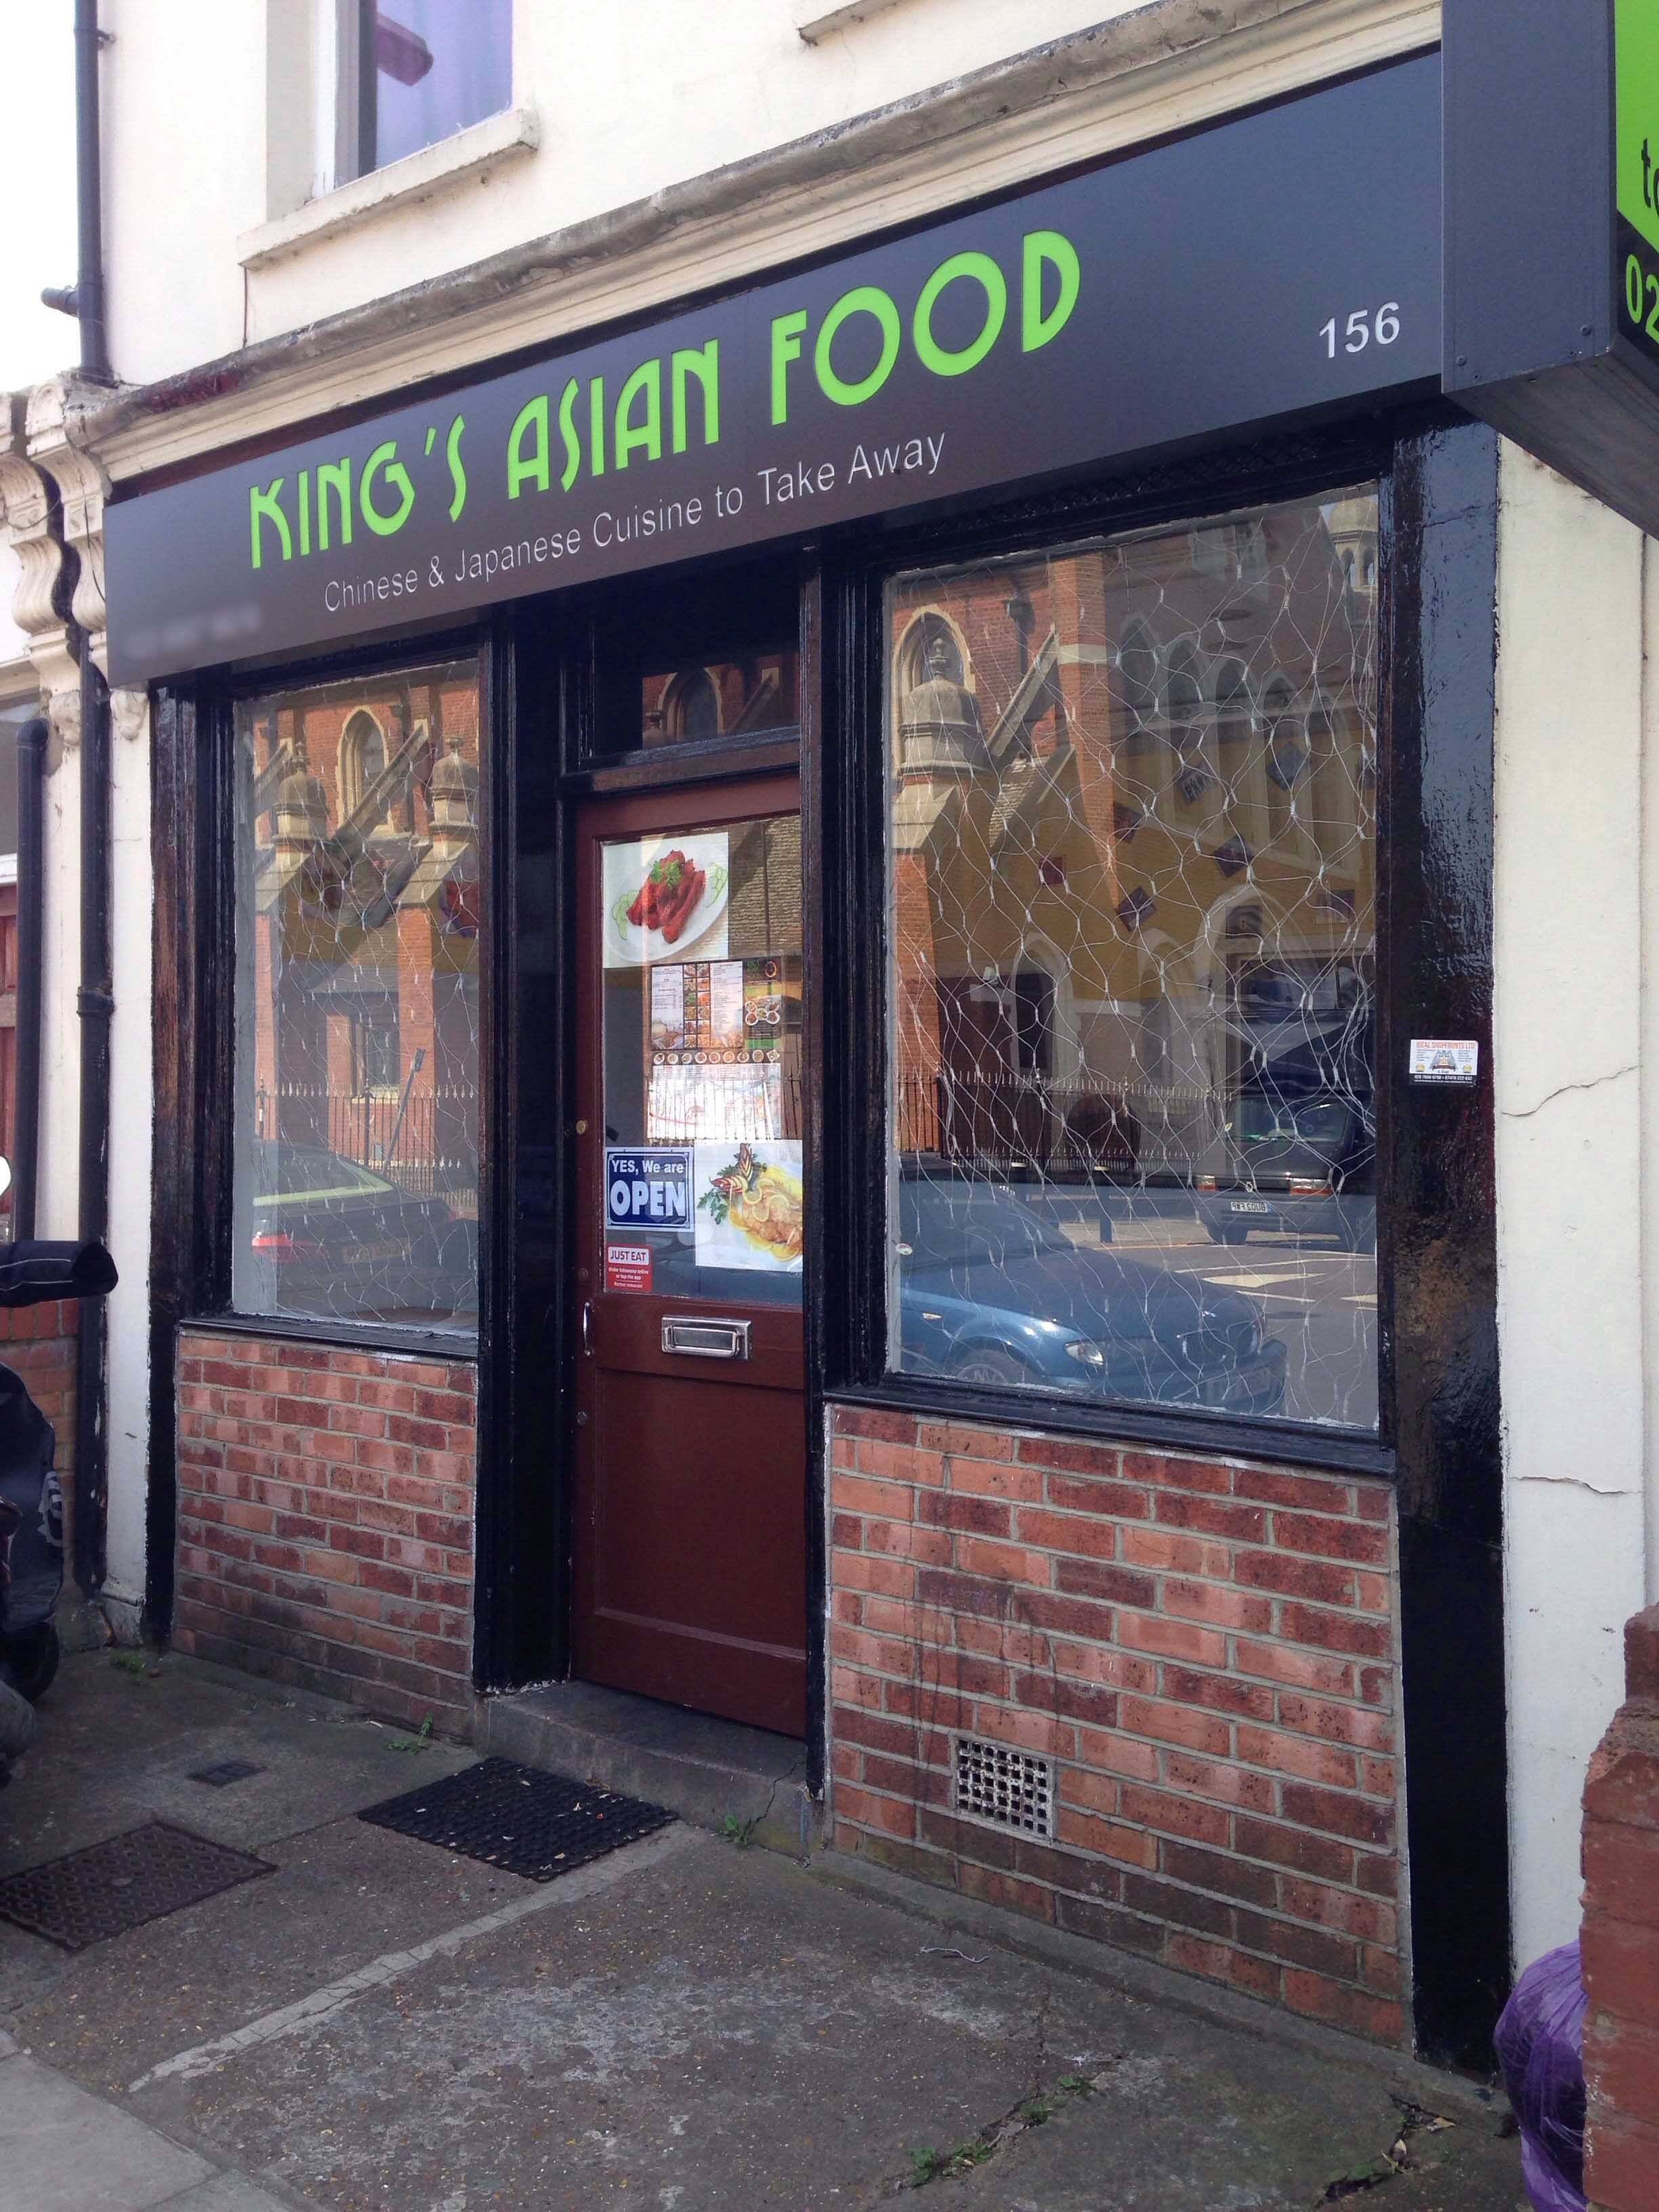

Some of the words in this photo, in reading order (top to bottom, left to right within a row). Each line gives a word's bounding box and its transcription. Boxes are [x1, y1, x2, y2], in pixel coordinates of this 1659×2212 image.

[1641, 138, 1659, 218] t
[1318, 301, 1400, 359] 156
[249, 412, 467, 569] KING'S
[506, 338, 720, 500] ASIAN
[770, 229, 1080, 426] FOOD
[325, 568, 417, 612] Chinese
[428, 555, 445, 588] &
[455, 527, 581, 583] Japanese
[592, 497, 702, 547] Cuisine
[715, 484, 743, 518] to
[757, 461, 835, 506] Take
[848, 432, 946, 485] Away
[611, 1160, 639, 1176] YES,
[642, 1160, 660, 1173] We
[664, 1163, 684, 1174] are
[610, 1179, 686, 1216] OPEN
[610, 1250, 630, 1261] JUST
[631, 1251, 647, 1262] EAT
